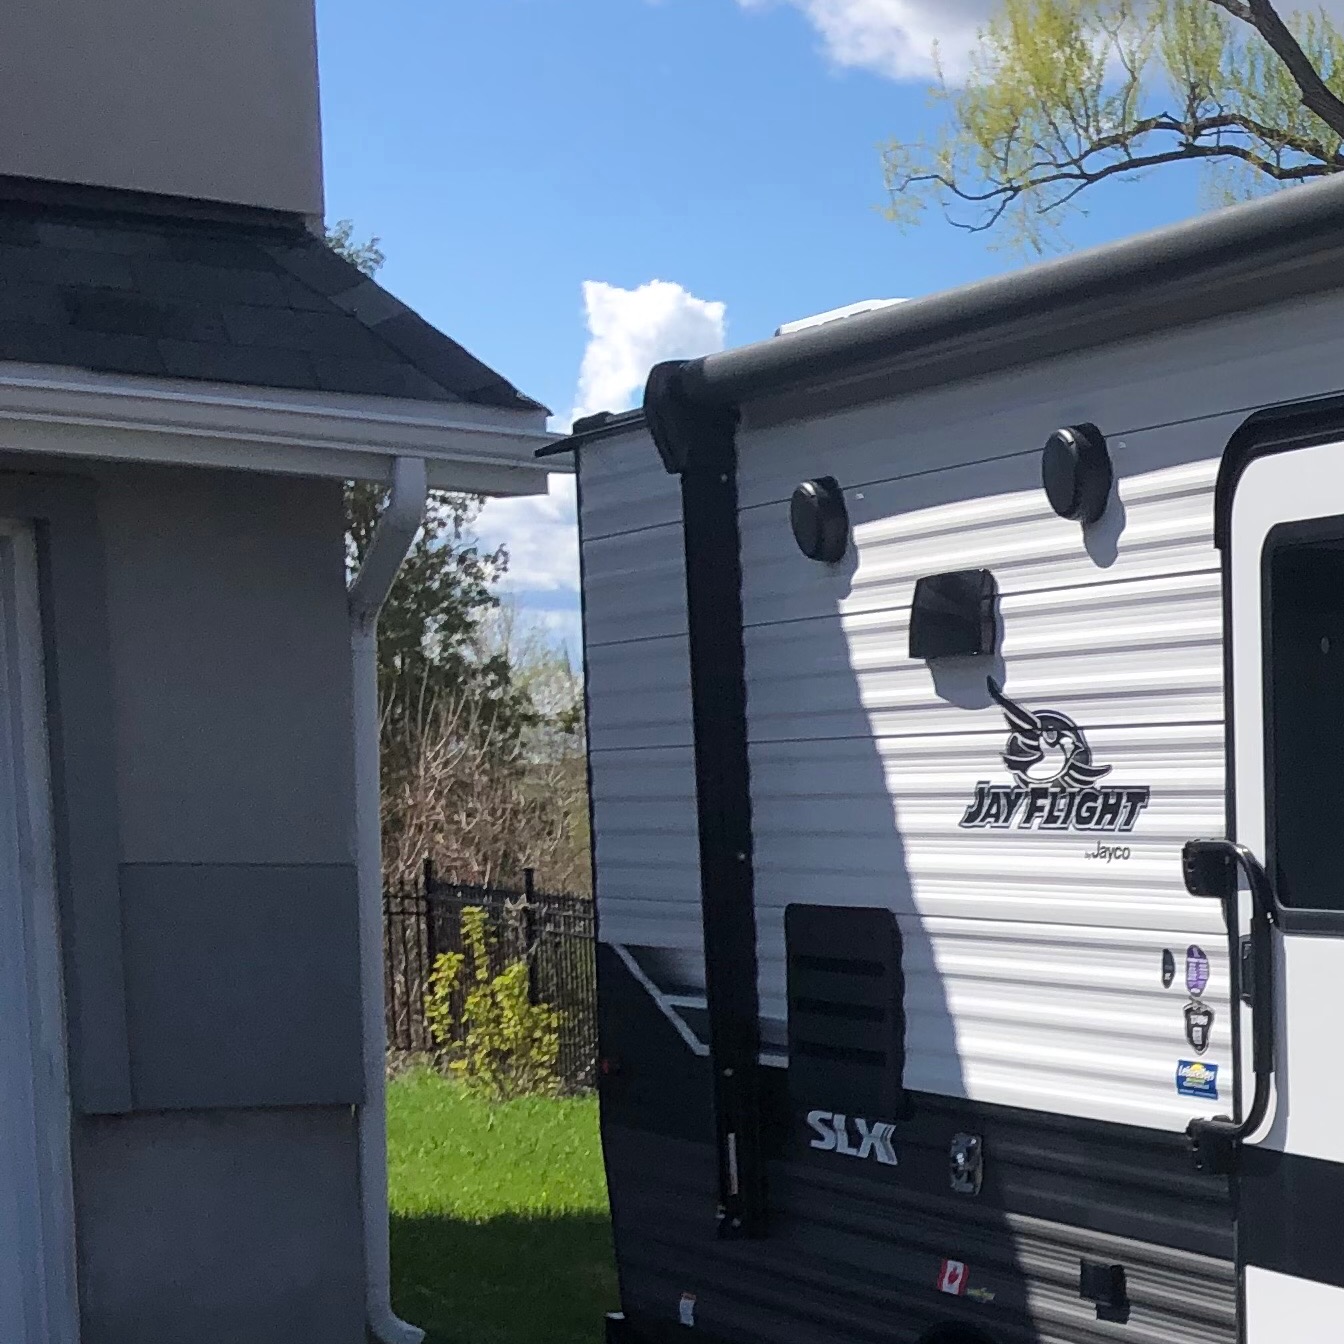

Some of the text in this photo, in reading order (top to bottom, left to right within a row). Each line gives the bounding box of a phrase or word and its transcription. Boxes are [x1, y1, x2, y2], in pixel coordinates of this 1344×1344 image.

[958, 781, 1150, 832] JAY FLIGHT
[1092, 840, 1131, 864] Jayco
[807, 1110, 898, 1166] SLX
